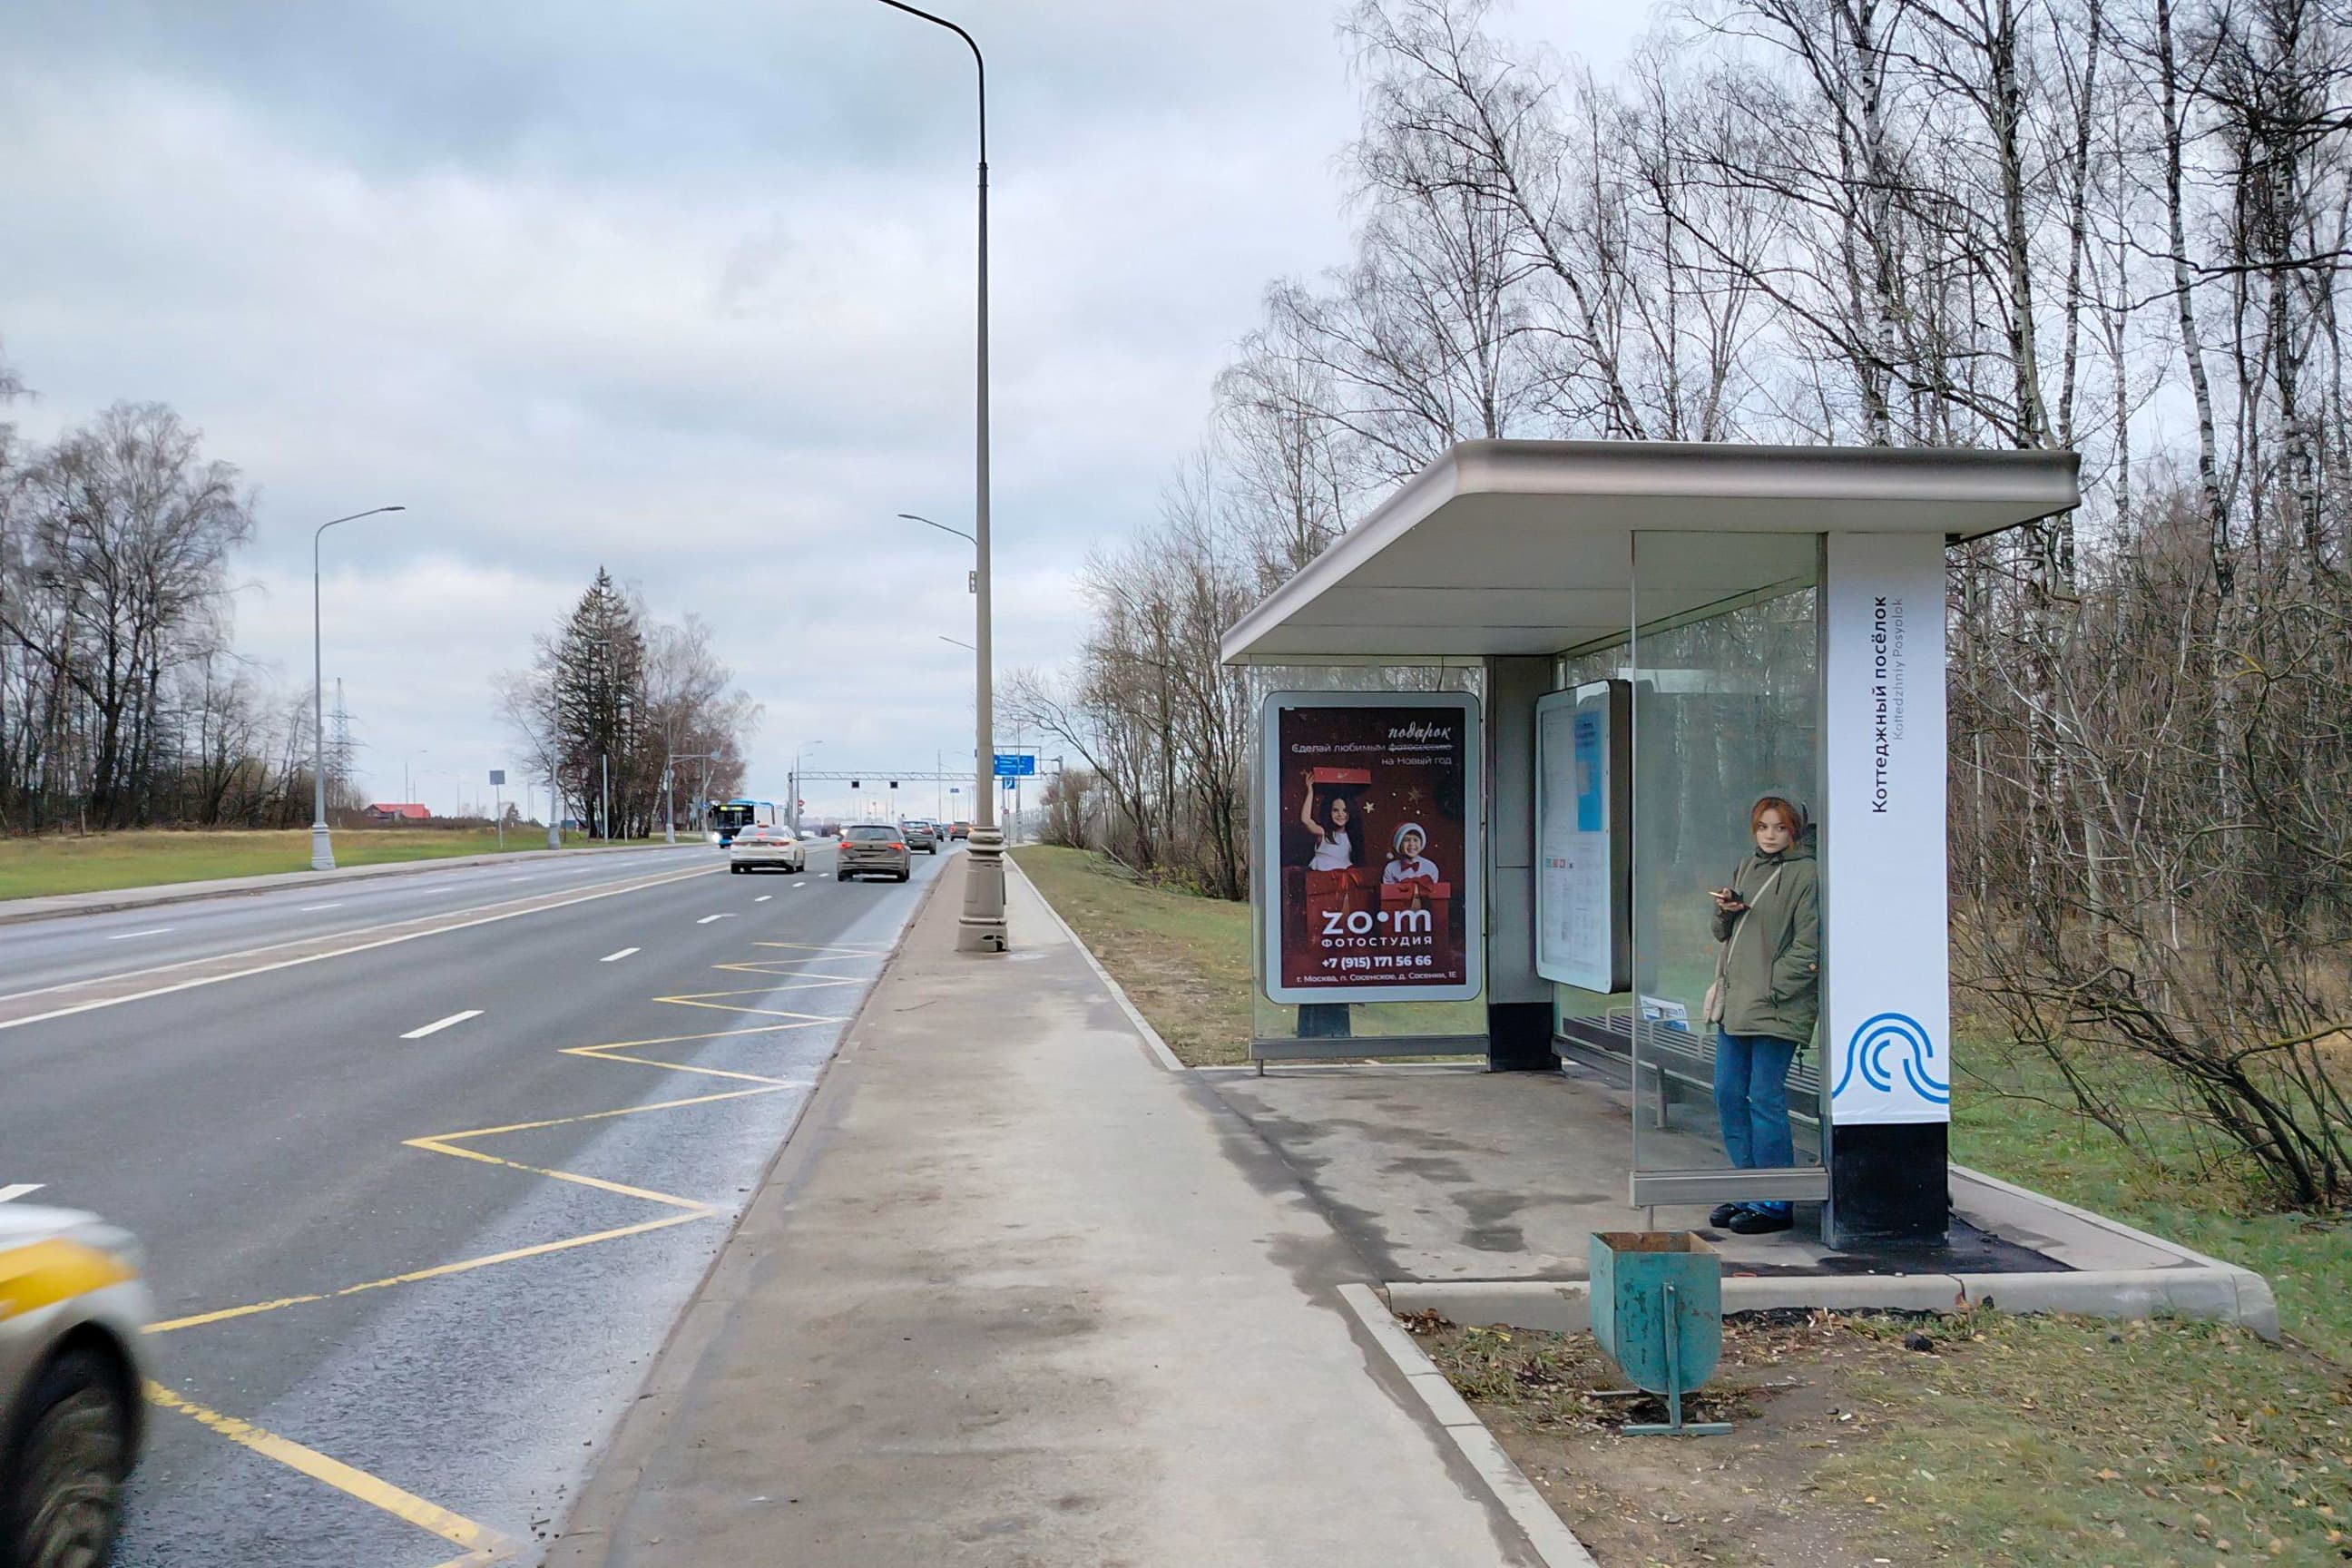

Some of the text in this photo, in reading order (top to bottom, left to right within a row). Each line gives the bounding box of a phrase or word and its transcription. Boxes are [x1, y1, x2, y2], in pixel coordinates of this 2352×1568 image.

[1871, 596, 1889, 813] Коттеджный посёлок
[1892, 662, 1906, 740] Kottedzhniy
[1387, 720, 1451, 743] подарок
[1334, 742, 1386, 752] любимым
[1397, 756, 1432, 765] Новый
[1435, 757, 1452, 765] год
[1321, 955, 1432, 970] +7 (915) 171 56 66
